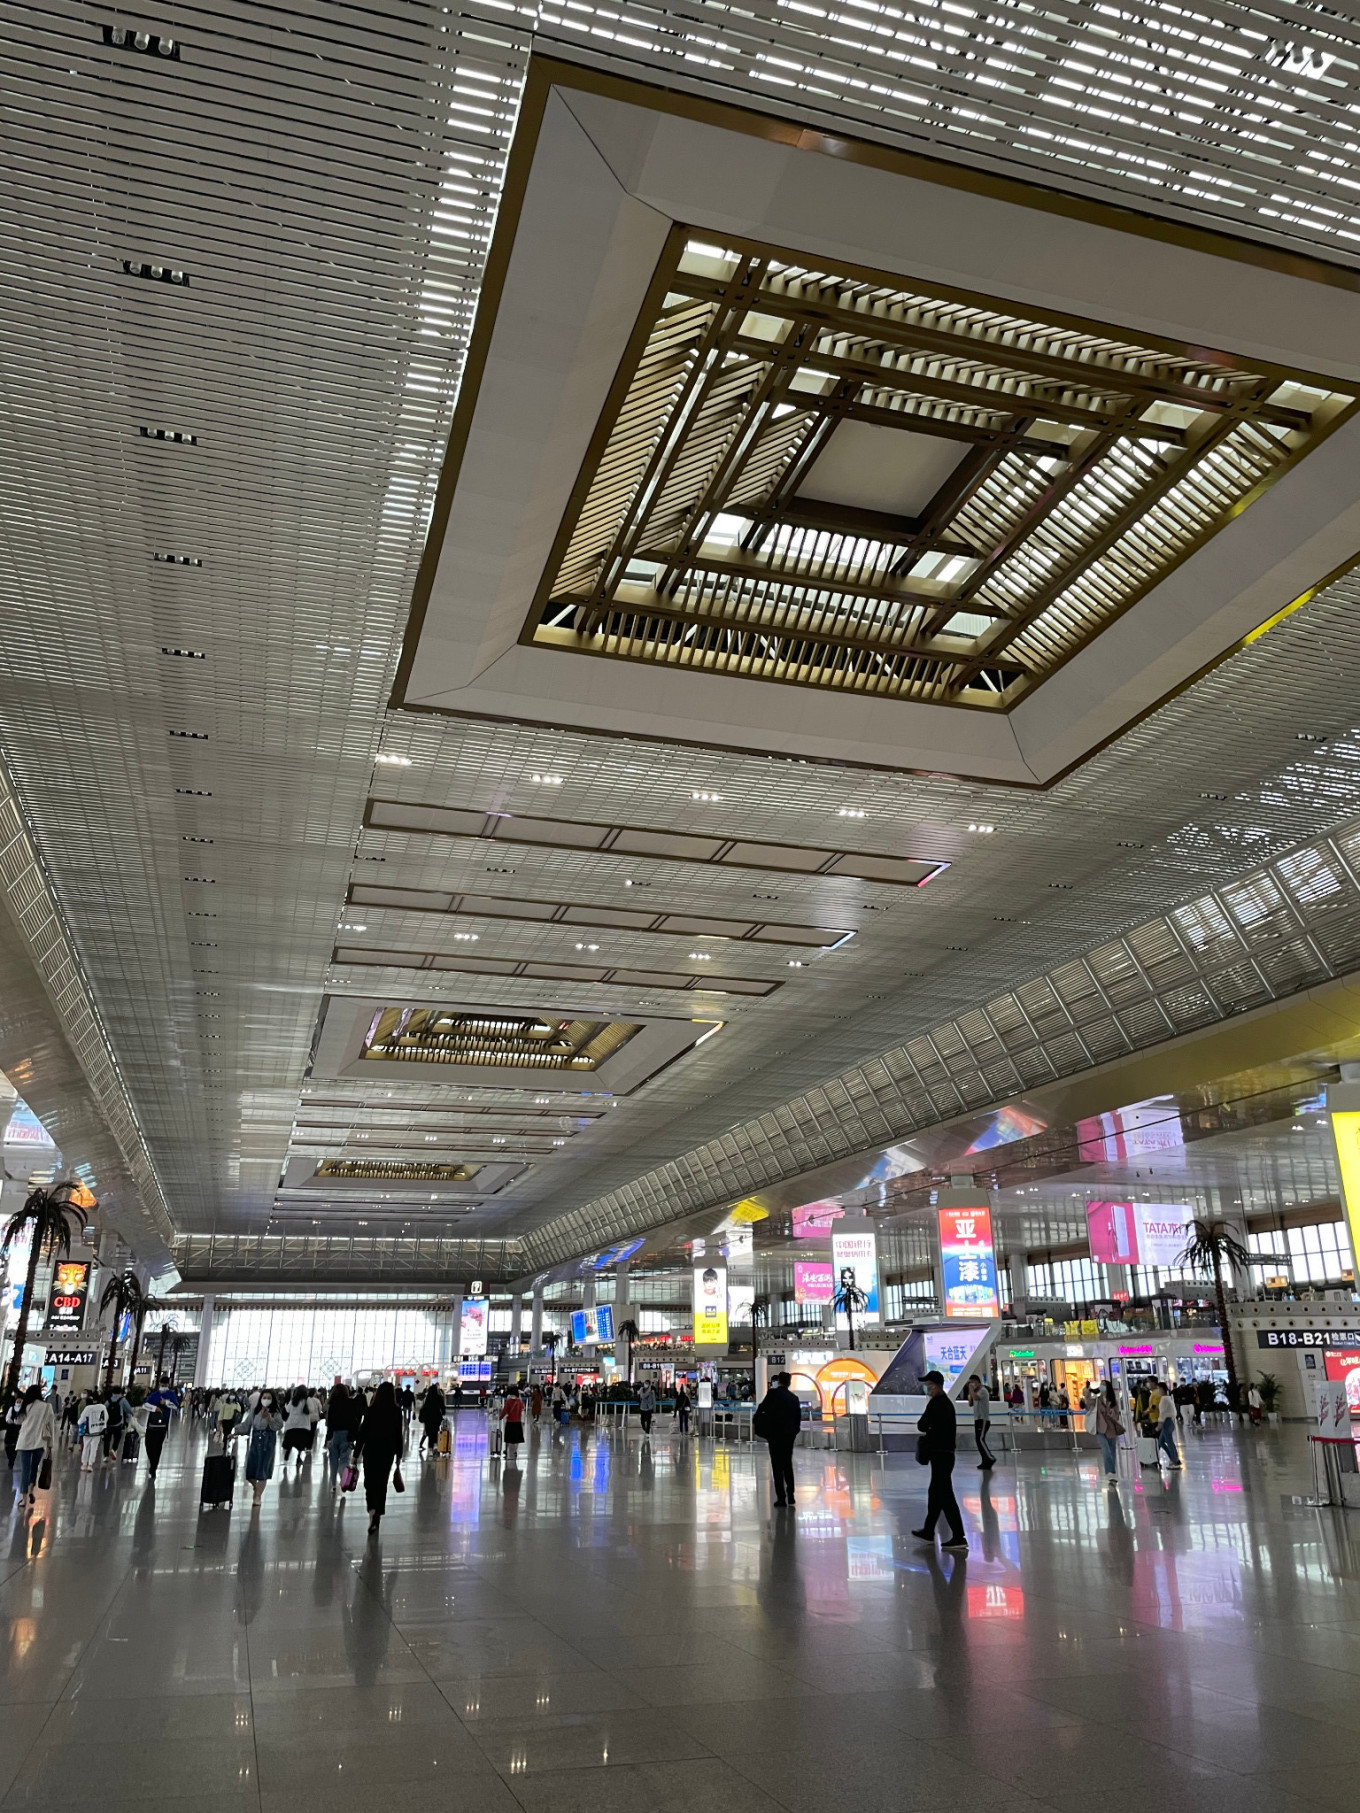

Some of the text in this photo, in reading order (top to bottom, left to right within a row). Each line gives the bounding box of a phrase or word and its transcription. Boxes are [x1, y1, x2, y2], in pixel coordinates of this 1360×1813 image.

[53, 1296, 81, 1308] CBD
[1267, 1332, 1355, 1345] B18-B21 检票口
[49, 1353, 93, 1363] A14-A17
